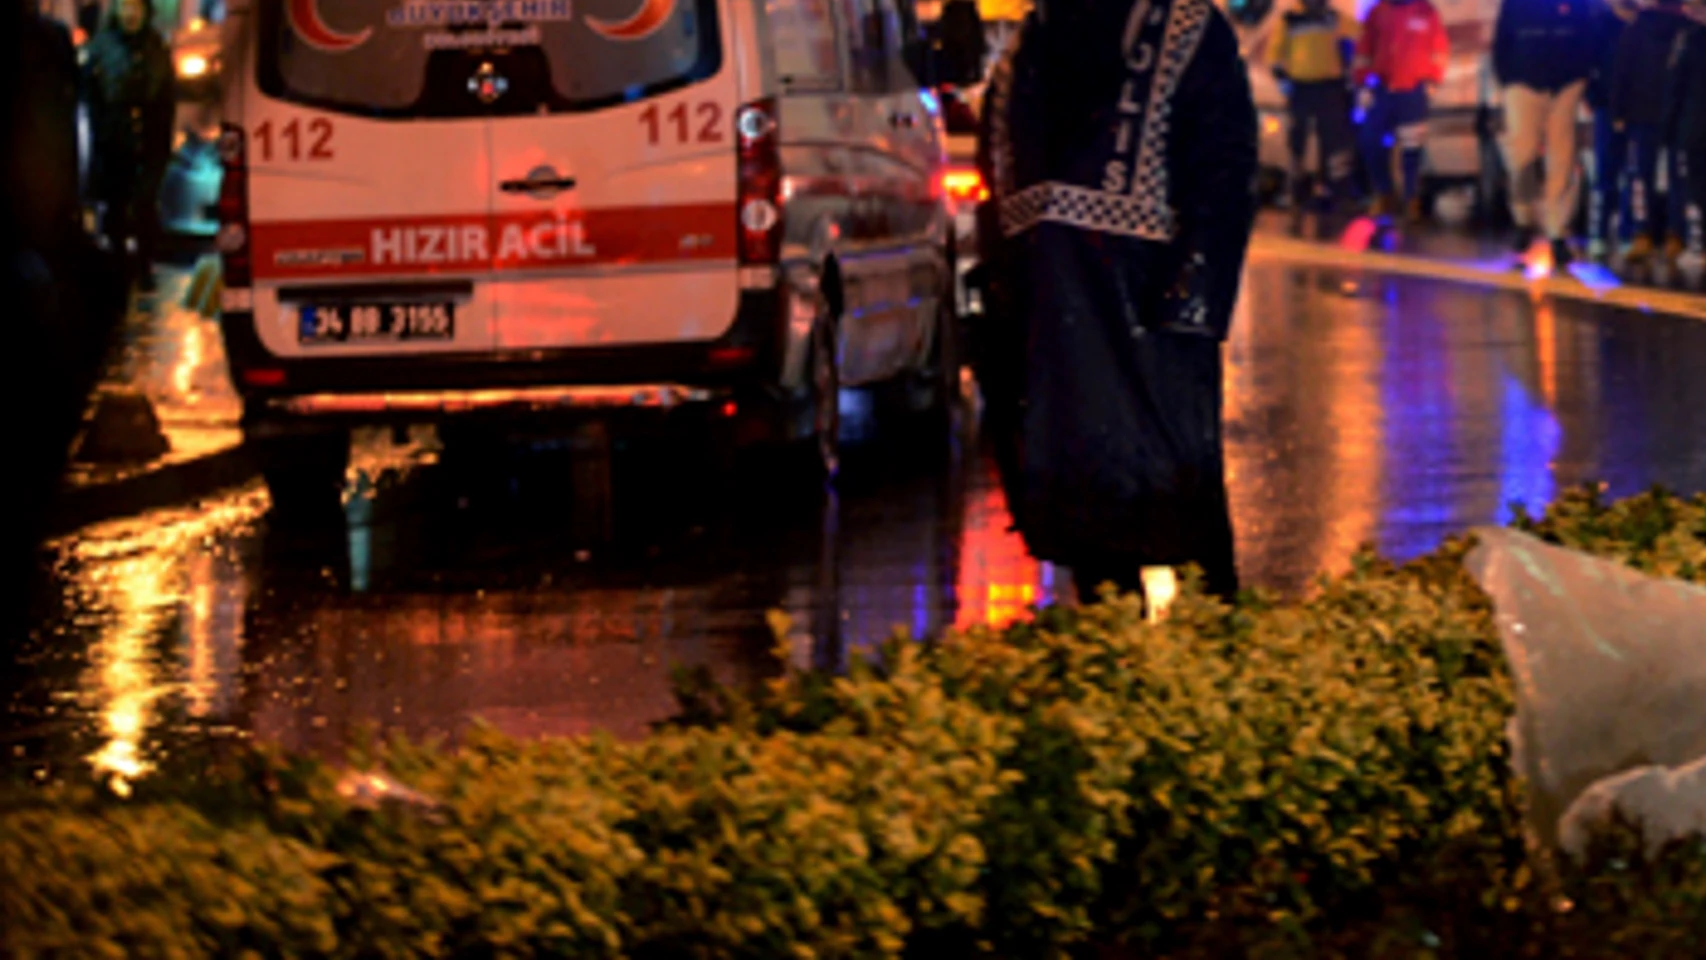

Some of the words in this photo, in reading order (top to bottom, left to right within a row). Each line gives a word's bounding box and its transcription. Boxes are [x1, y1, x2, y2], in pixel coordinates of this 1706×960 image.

[254, 117, 335, 162] 112
[638, 101, 724, 145] 112
[371, 227, 489, 265] HIZIR
